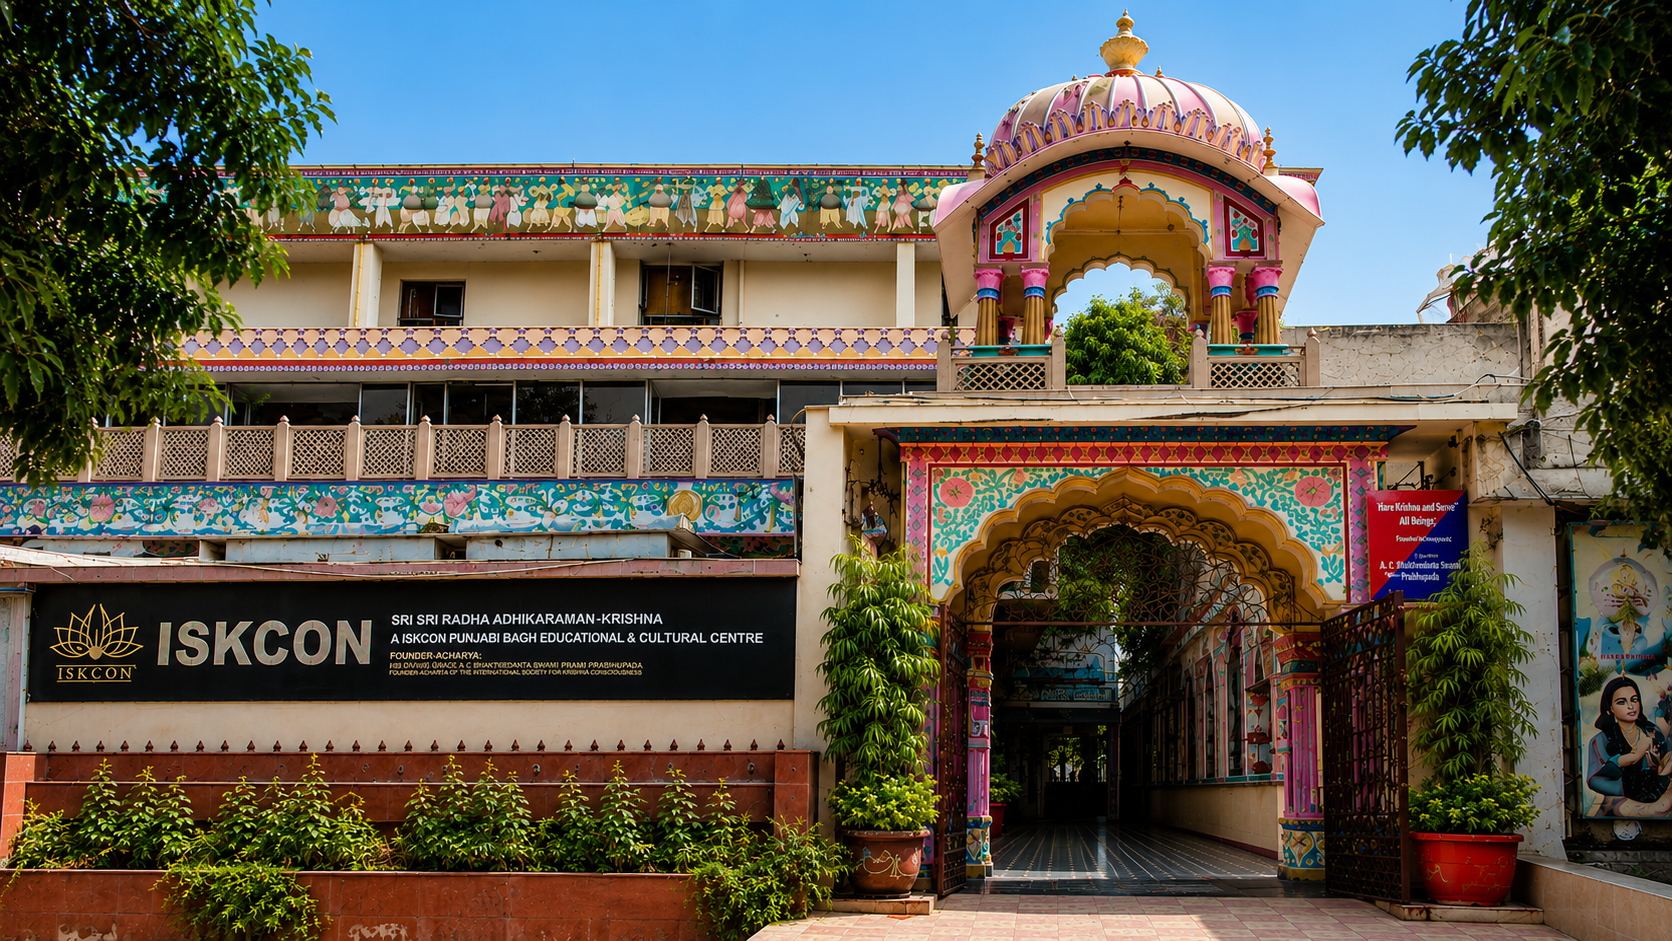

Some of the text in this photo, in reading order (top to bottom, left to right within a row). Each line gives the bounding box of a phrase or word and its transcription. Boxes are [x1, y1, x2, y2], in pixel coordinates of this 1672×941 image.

[1422, 502, 1435, 512] and
[1399, 516, 1410, 526] All
[391, 614, 413, 626] SRI
[416, 614, 438, 626] SRI
[441, 613, 490, 626] RADHA
[156, 619, 373, 667] ISKCON
[390, 632, 764, 644] A ISKCON PUNJABI BAGH EDUCATIONAL & CULTURAL CENTRE
[57, 667, 135, 680] ISKCON
